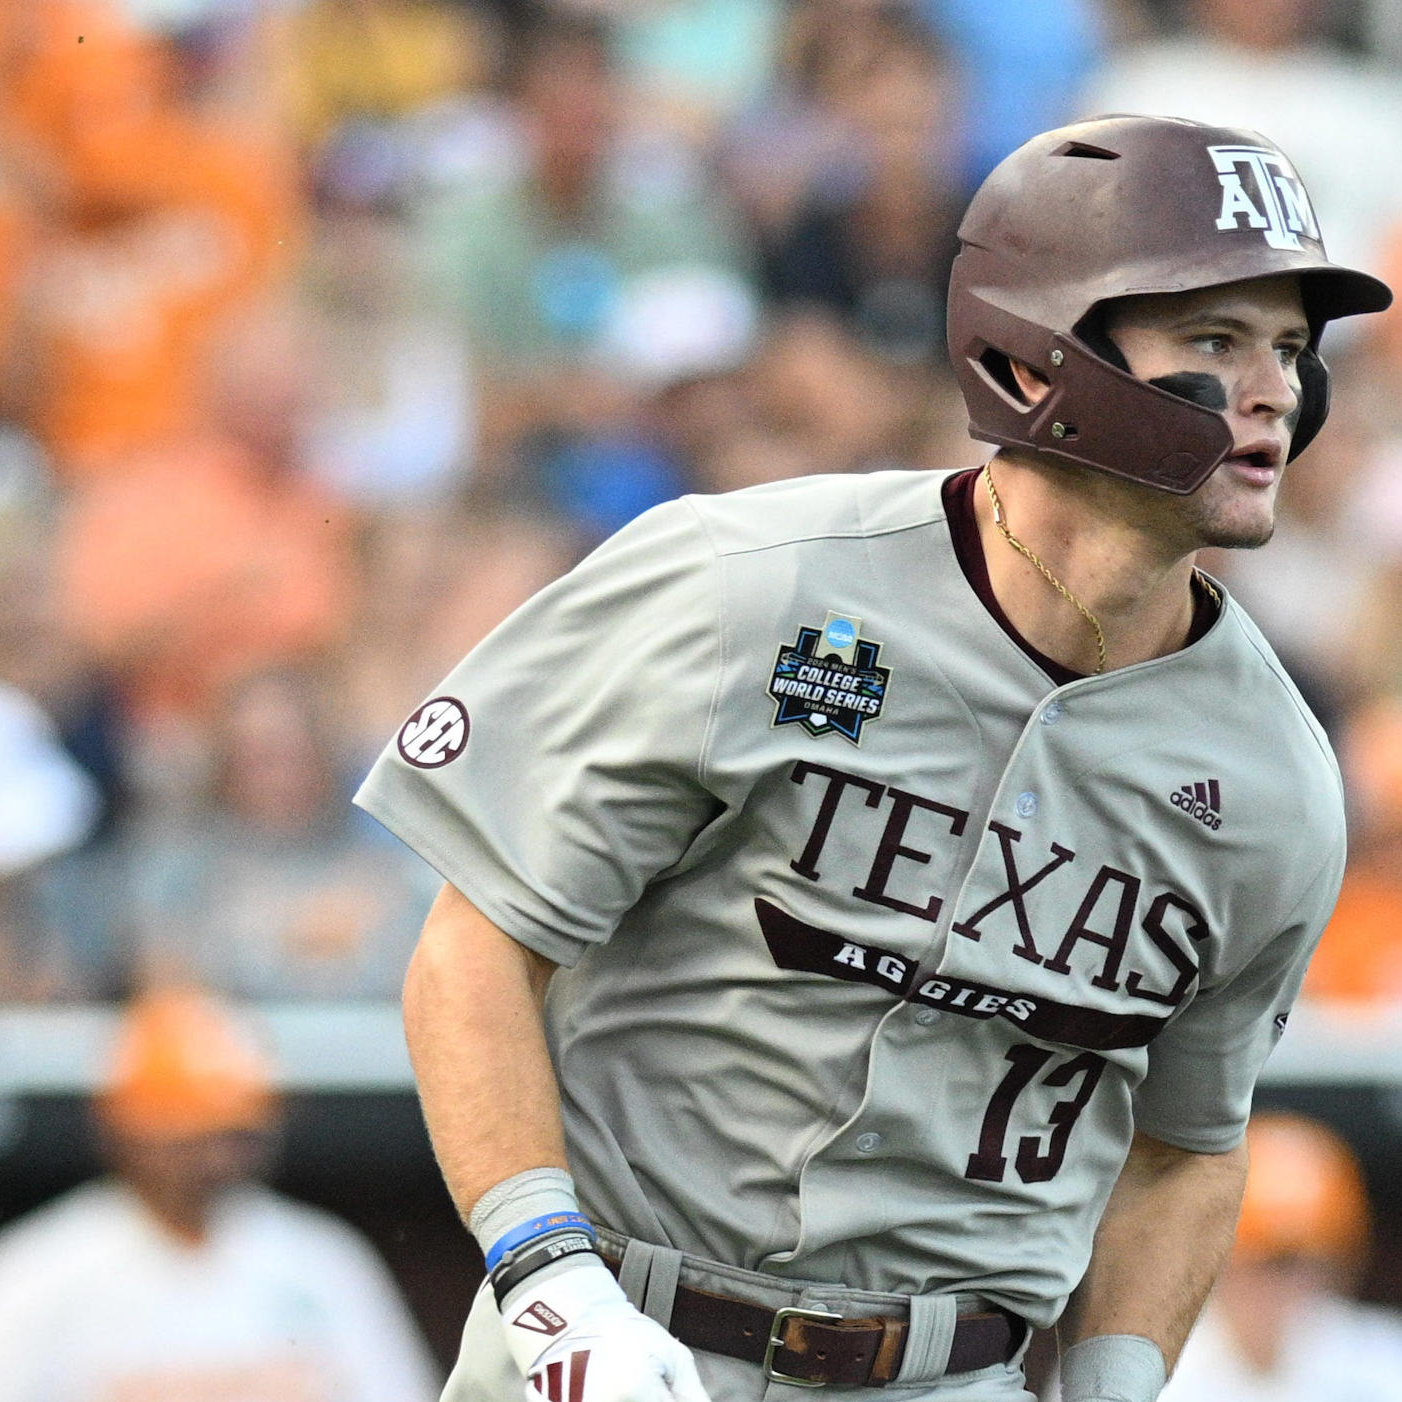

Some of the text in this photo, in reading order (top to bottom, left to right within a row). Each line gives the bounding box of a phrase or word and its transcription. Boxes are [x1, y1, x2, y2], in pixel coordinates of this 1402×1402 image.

[797, 665, 862, 692] COLLEGE
[831, 662, 856, 674] MEN'S
[773, 677, 879, 714] WORLD SERIES
[804, 701, 839, 715] OMAHA
[401, 701, 465, 764] SEC
[1170, 792, 1222, 830] adidas
[788, 760, 1210, 1006] TEXAS
[833, 943, 1037, 1021] AGGIES
[964, 1044, 1108, 1184] 13
